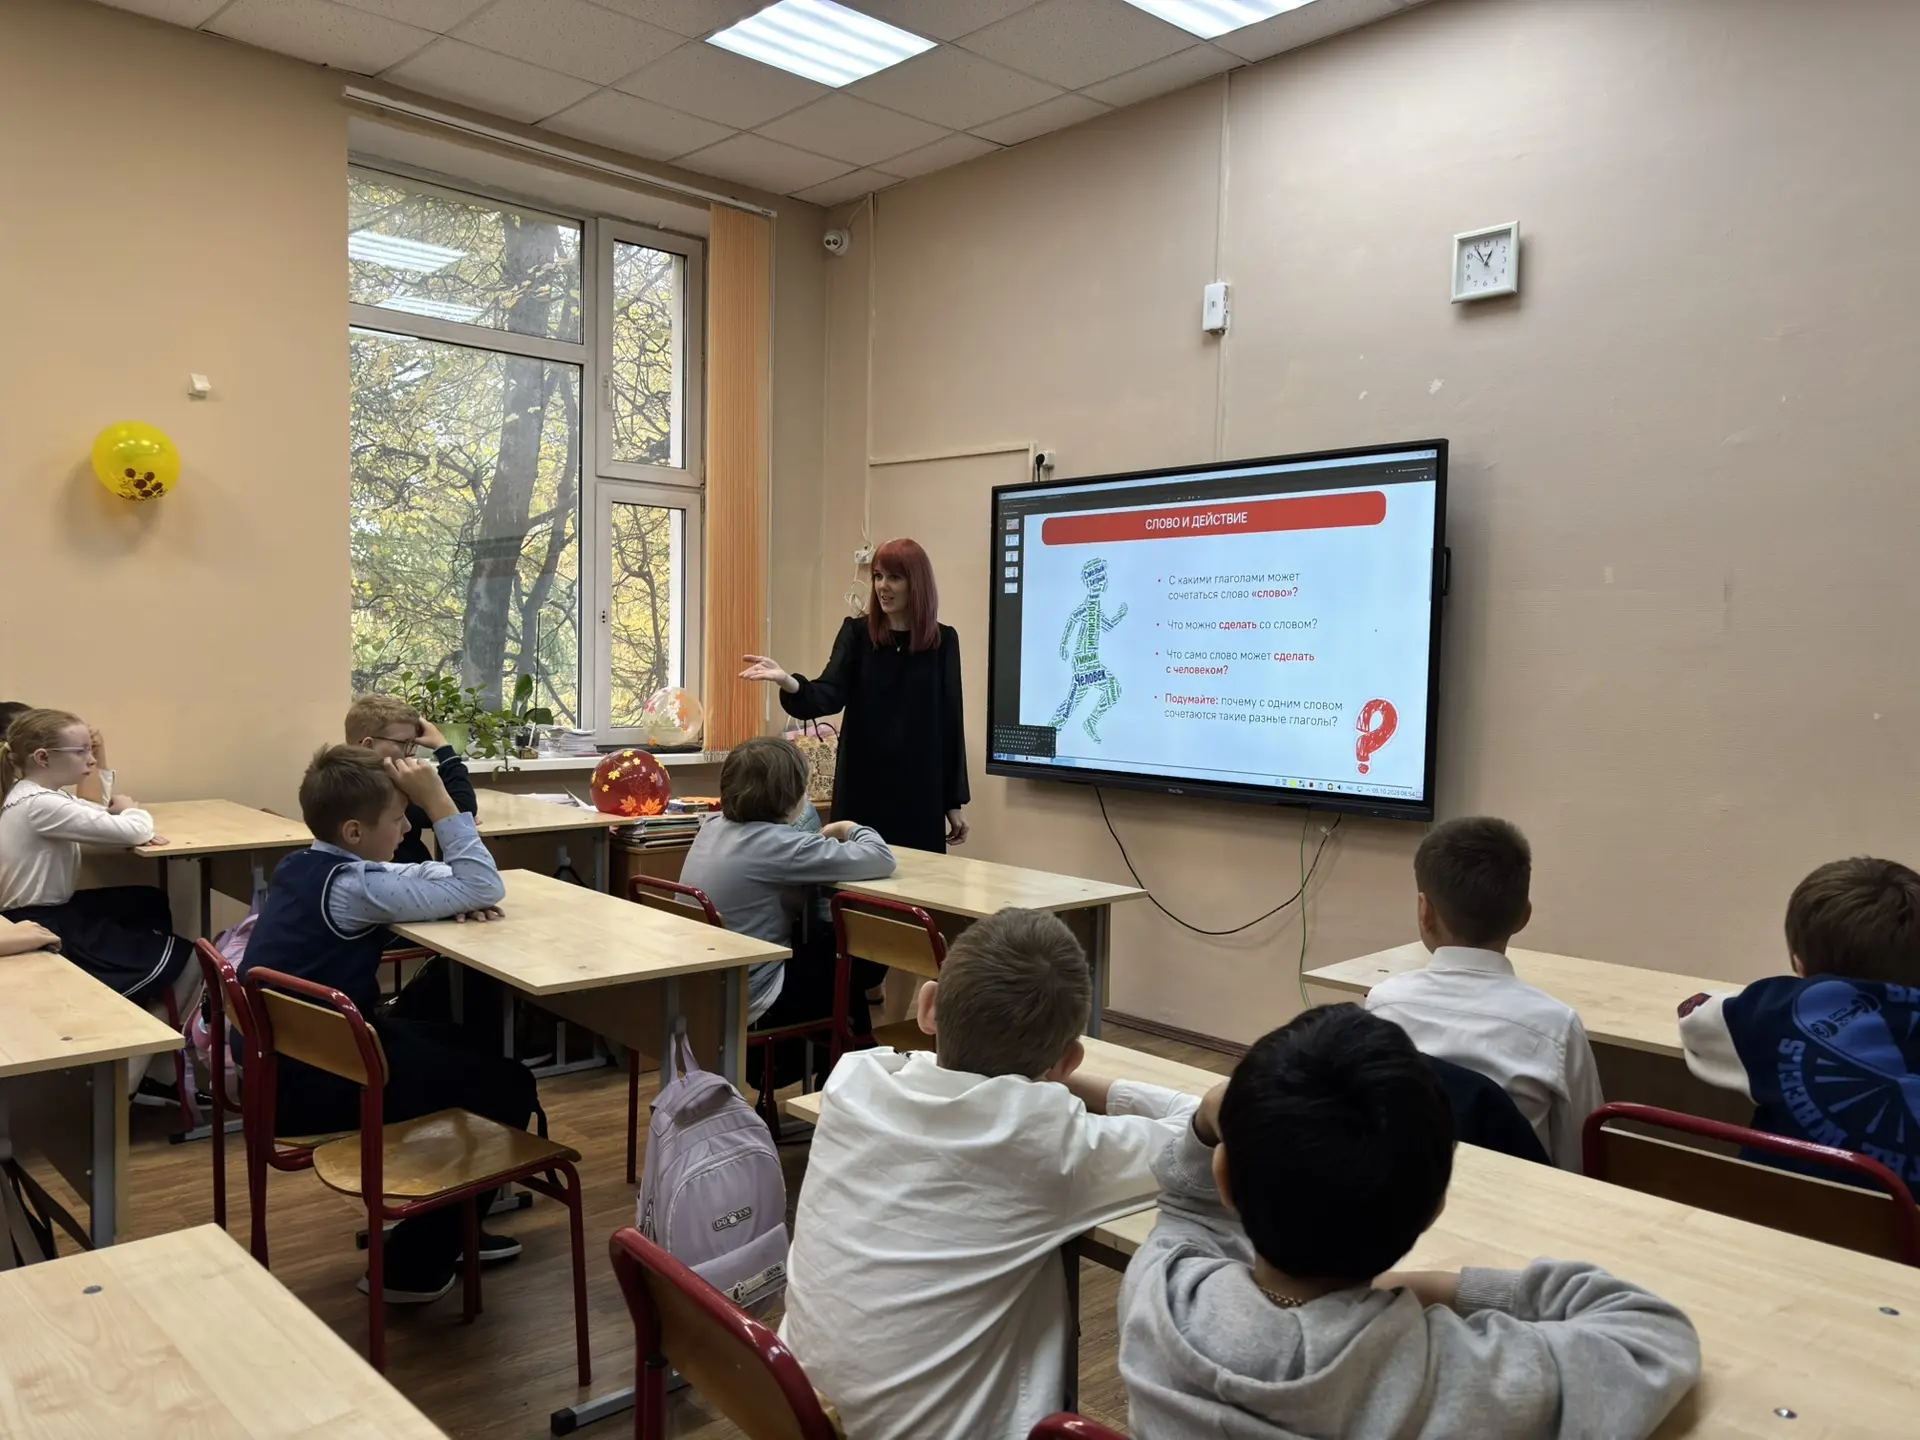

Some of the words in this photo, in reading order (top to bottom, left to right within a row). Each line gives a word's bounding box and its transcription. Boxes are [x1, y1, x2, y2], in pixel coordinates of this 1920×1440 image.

[1145, 517, 1180, 530] СЛОВО
[1182, 516, 1190, 528] И
[1192, 512, 1248, 528] ДЕЙСТВИЕ
[1168, 576, 1176, 585] С
[1178, 576, 1212, 584] какими
[1214, 574, 1264, 584] глаголами
[1268, 572, 1300, 582] может
[1168, 590, 1218, 600] сочетаться
[1220, 590, 1249, 599] слово
[1252, 586, 1298, 598] «слово»?
[1167, 620, 1183, 629] Что
[1186, 621, 1216, 629] можно
[1219, 621, 1256, 630] сделать
[1274, 618, 1318, 629] словом?
[1166, 650, 1182, 660] Что
[1184, 651, 1207, 660] само
[1210, 652, 1237, 660] слово
[1240, 652, 1271, 660] может
[1274, 652, 1315, 662] сделать
[1174, 665, 1228, 675] человеком?
[1074, 670, 1107, 686] Человек
[1165, 693, 1219, 705] Подумайте:
[1221, 697, 1257, 708] почему
[1268, 700, 1300, 709] одним
[1304, 701, 1343, 710] словом
[1164, 710, 1217, 720] сочетаются
[1219, 712, 1246, 721] такие
[1249, 714, 1286, 725] разные
[1289, 716, 1338, 727] глаголы?
[1778, 1038, 1848, 1147] WHEELS
